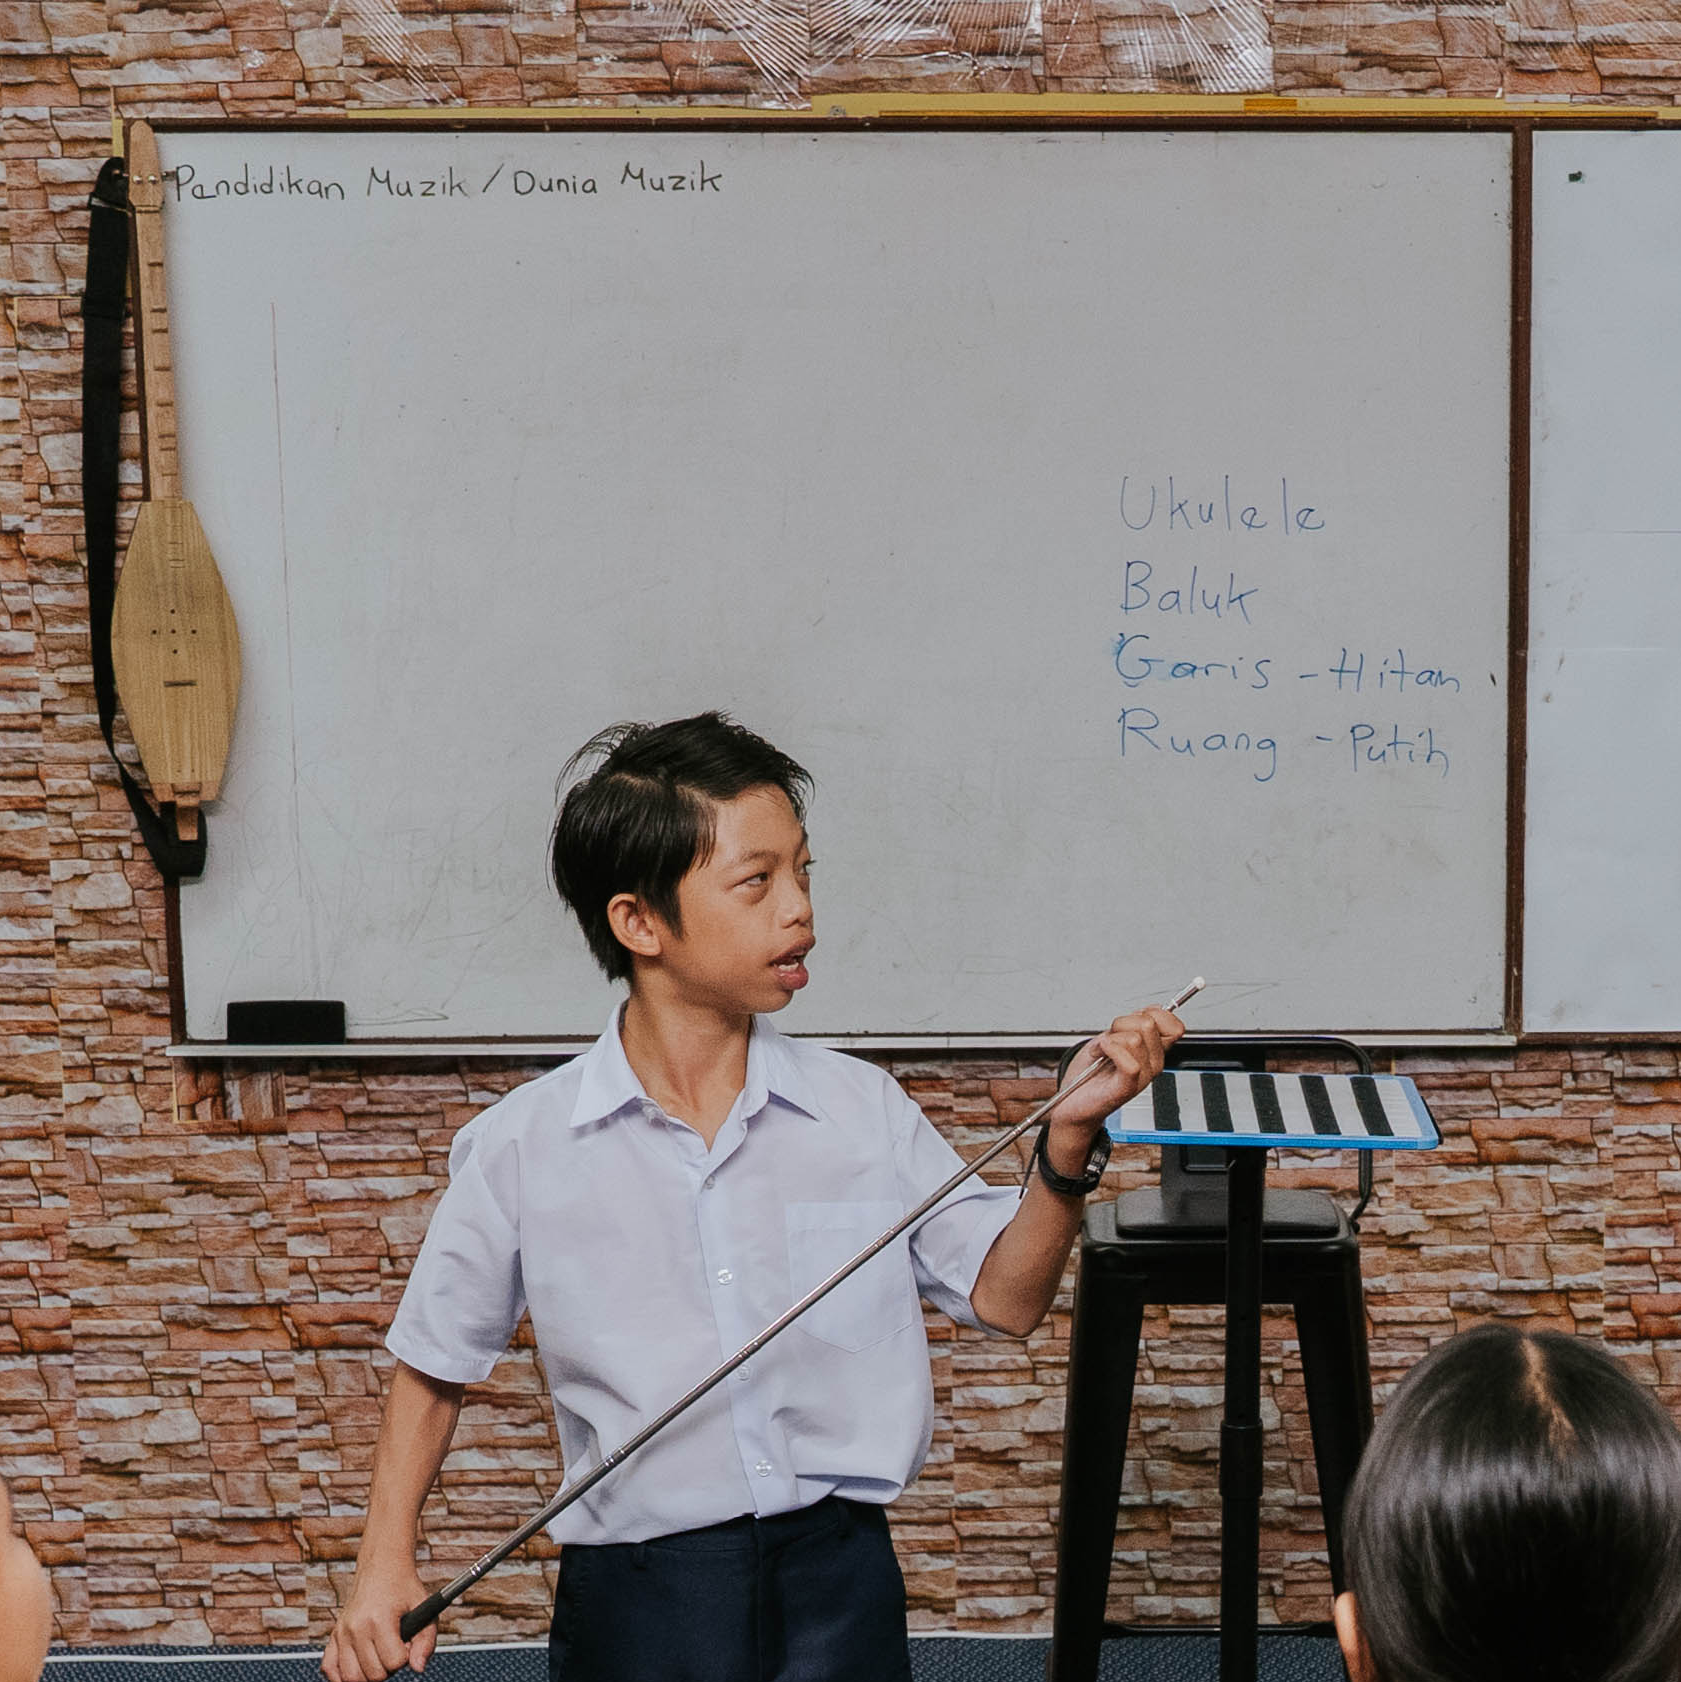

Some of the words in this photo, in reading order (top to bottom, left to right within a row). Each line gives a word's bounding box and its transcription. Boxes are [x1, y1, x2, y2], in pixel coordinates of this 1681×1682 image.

[366, 165, 470, 199] Muzik
[513, 169, 598, 196] Dunia
[620, 159, 724, 193] Muzik
[1119, 474, 1326, 535] Ukulele
[1119, 560, 1260, 625] Baluk
[1114, 633, 1272, 690] Garis
[1116, 707, 1278, 782] Ruang
[1349, 723, 1450, 779] Putih
